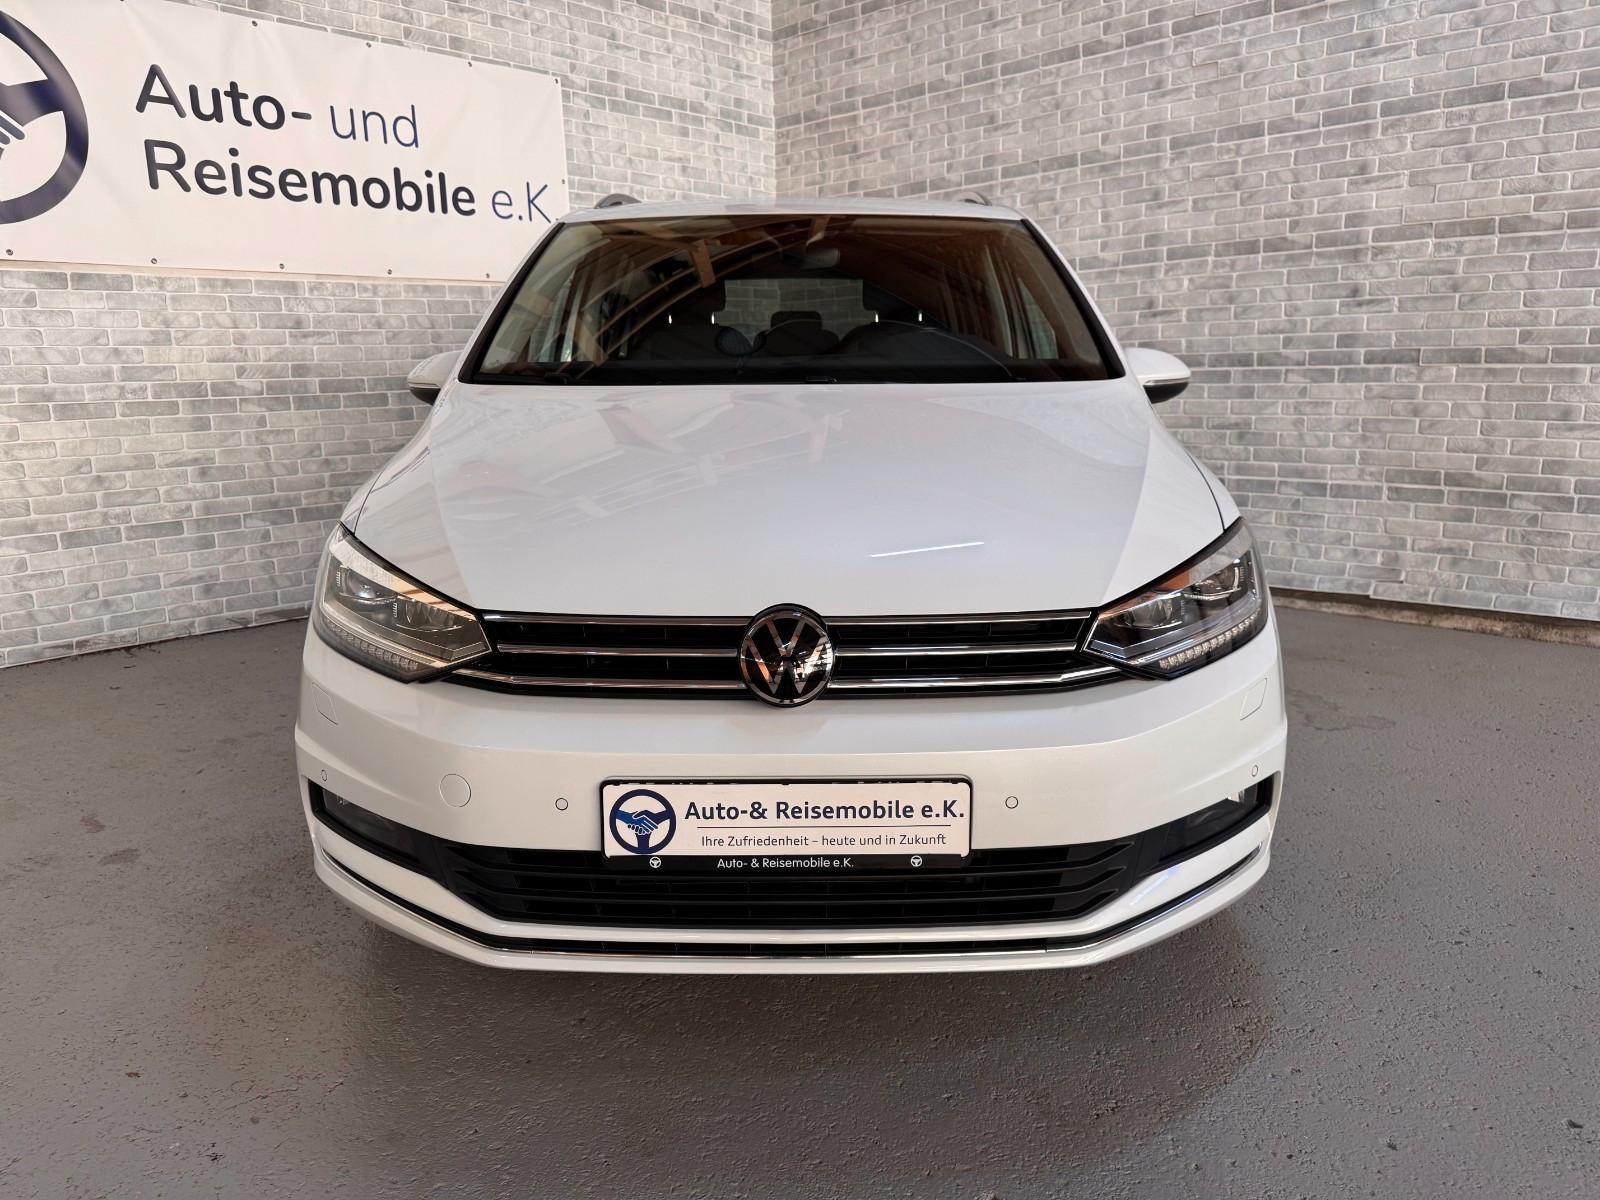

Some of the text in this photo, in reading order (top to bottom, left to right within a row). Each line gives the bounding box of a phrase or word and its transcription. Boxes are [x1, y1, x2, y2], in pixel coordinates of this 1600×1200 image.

[135, 63, 419, 148] Auto- und
[143, 138, 477, 217] Reisemobile
[776, 800, 914, 819] Reisemobile
[921, 799, 965, 819] e.K.
[701, 836, 725, 847] Ihre
[728, 835, 809, 847] Zufriedenheit
[821, 834, 856, 847] heute
[859, 834, 883, 847] und
[885, 834, 897, 846] in
[899, 833, 947, 846] Zukunft
[717, 857, 854, 869] Auto- & Reisemobile e.K.
